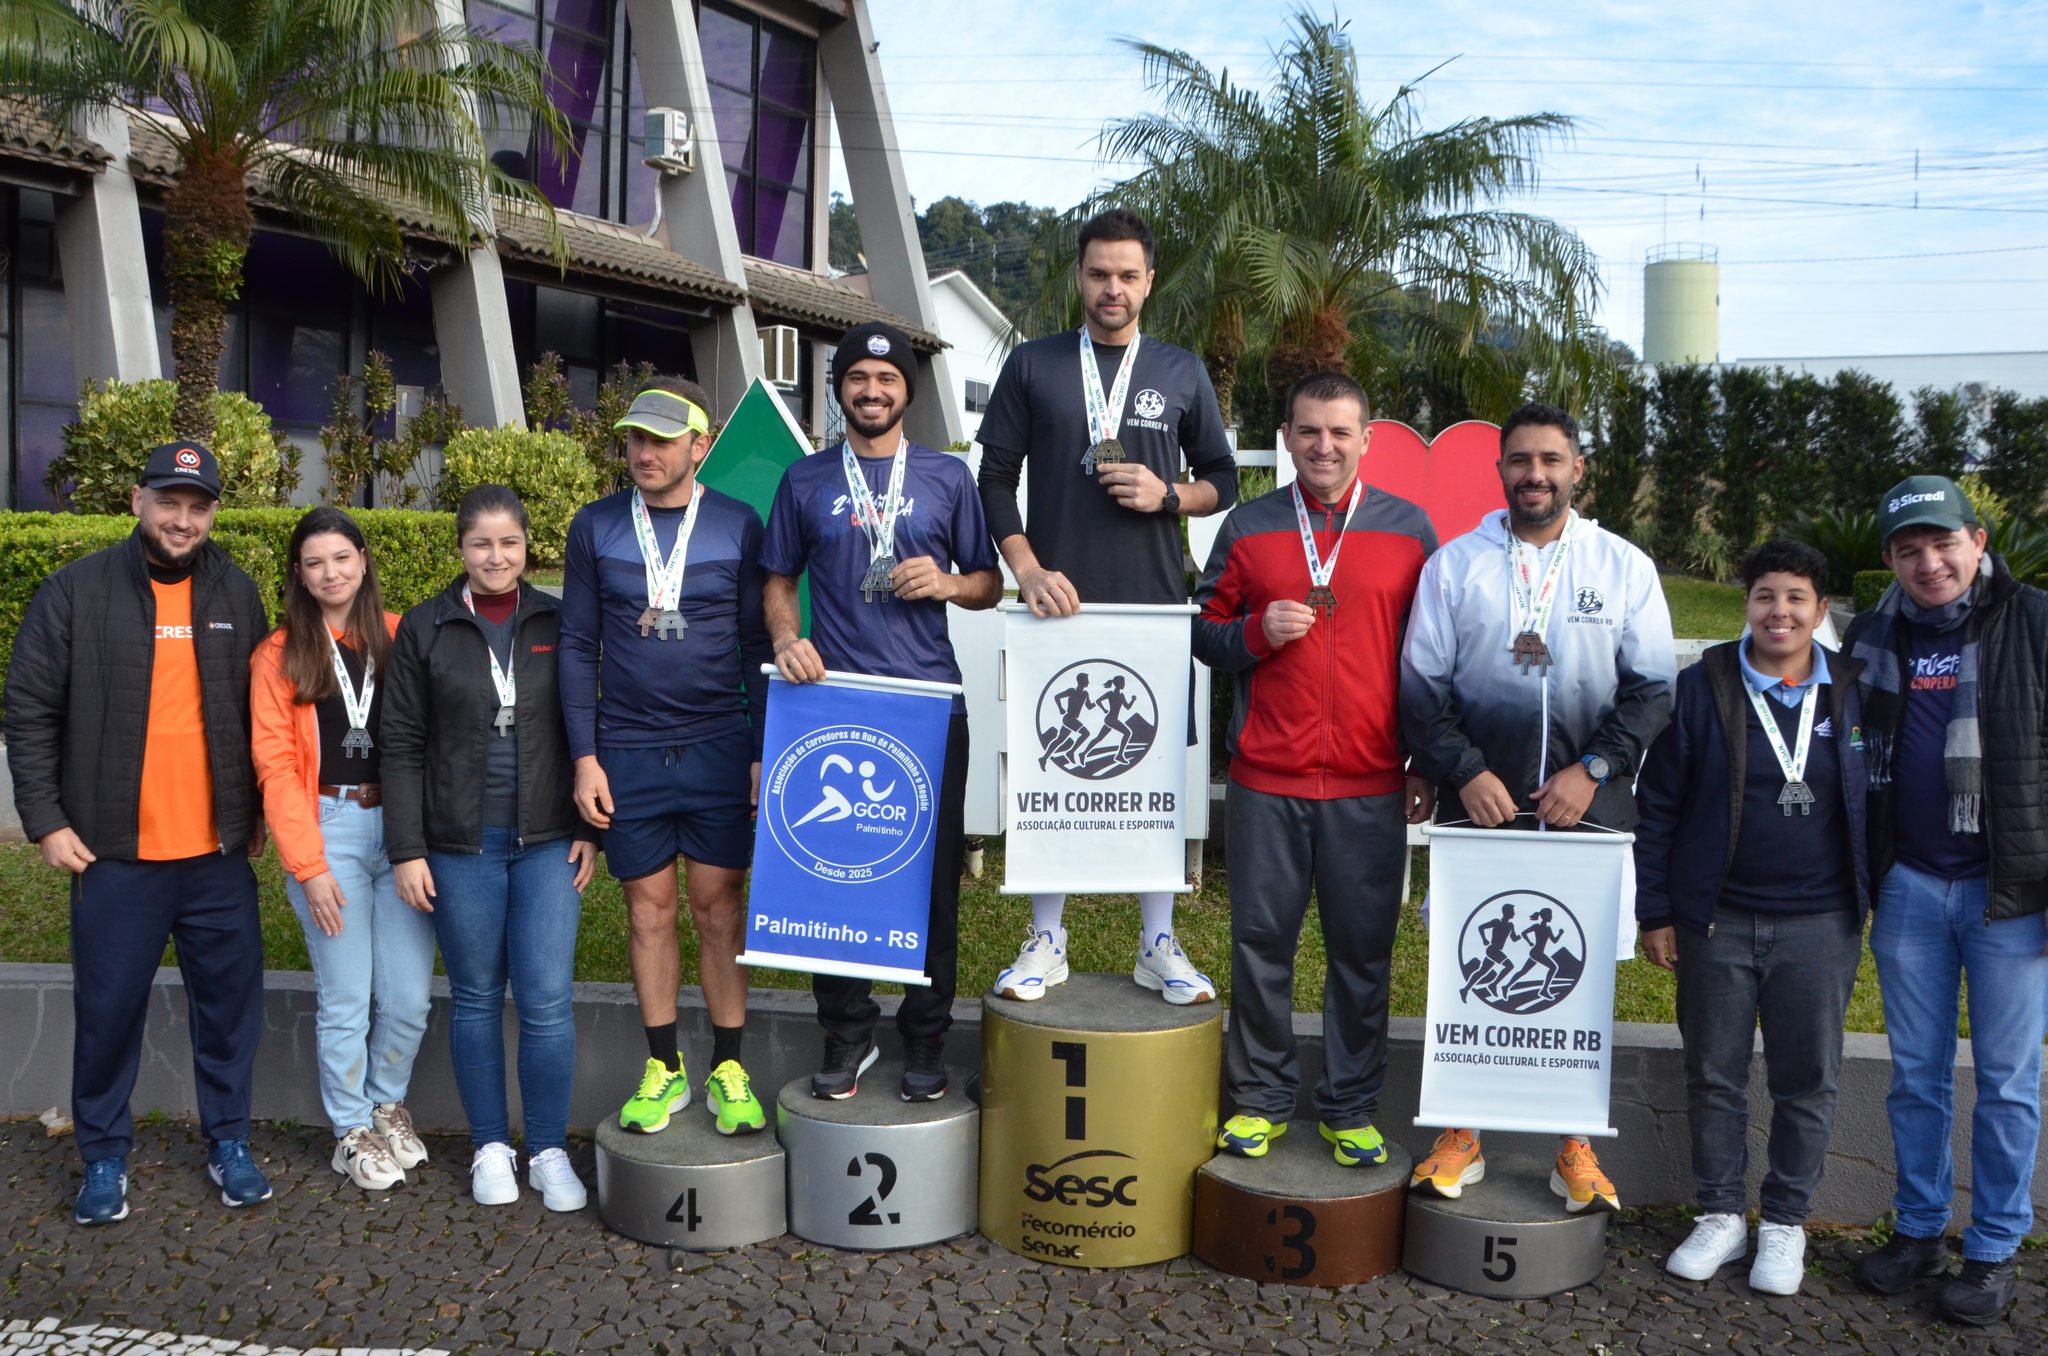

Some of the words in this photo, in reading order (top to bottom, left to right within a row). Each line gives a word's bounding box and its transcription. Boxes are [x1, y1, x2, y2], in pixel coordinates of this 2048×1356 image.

[1126, 418, 1140, 426] VEM
[1900, 490, 1945, 507] Sicredi
[668, 548, 680, 573] CRESOL
[1554, 542, 1567, 567] CRESOL
[1567, 616, 1580, 624] VEM
[1582, 616, 1604, 625] CORRER
[772, 754, 797, 795] Associação
[796, 745, 806, 755] de
[804, 730, 849, 750] Corredores
[850, 730, 860, 740] de
[862, 732, 876, 744] Rua
[878, 738, 888, 748] de
[918, 784, 930, 812] Região
[1778, 744, 1793, 774] CRESOL
[854, 802, 906, 822] GCOR
[1016, 792, 1058, 812] VEM
[1065, 792, 1142, 812] CORRER
[1149, 792, 1176, 812] RB
[856, 824, 904, 836] Palmitinho
[1016, 818, 1071, 832] ASSOCIAÇÃO
[1074, 820, 1117, 830] CULTURAL
[1120, 820, 1124, 830] E
[1126, 820, 1175, 830] ESPORTIVA
[814, 861, 846, 878] Desde
[848, 867, 872, 879] 2025
[754, 914, 868, 944] Palmitinho
[888, 931, 918, 950] RS
[1436, 1024, 1478, 1046] VEM
[1485, 1025, 1566, 1050] CORRER
[1573, 1029, 1601, 1052] RB
[1434, 1052, 1491, 1066] ASSOCIAÇÃO
[1493, 1055, 1538, 1068] CULTURAL
[1541, 1058, 1546, 1068] E
[1549, 1058, 1600, 1070] ESPORTIVA
[1052, 1041, 1086, 1140] 1
[847, 1152, 900, 1226] 2
[1023, 1160, 1138, 1208] Sesc
[665, 1188, 702, 1232] 4
[1022, 1235, 1080, 1260] Senac
[1264, 1205, 1317, 1280] 3
[1482, 1236, 1518, 1282] 5
